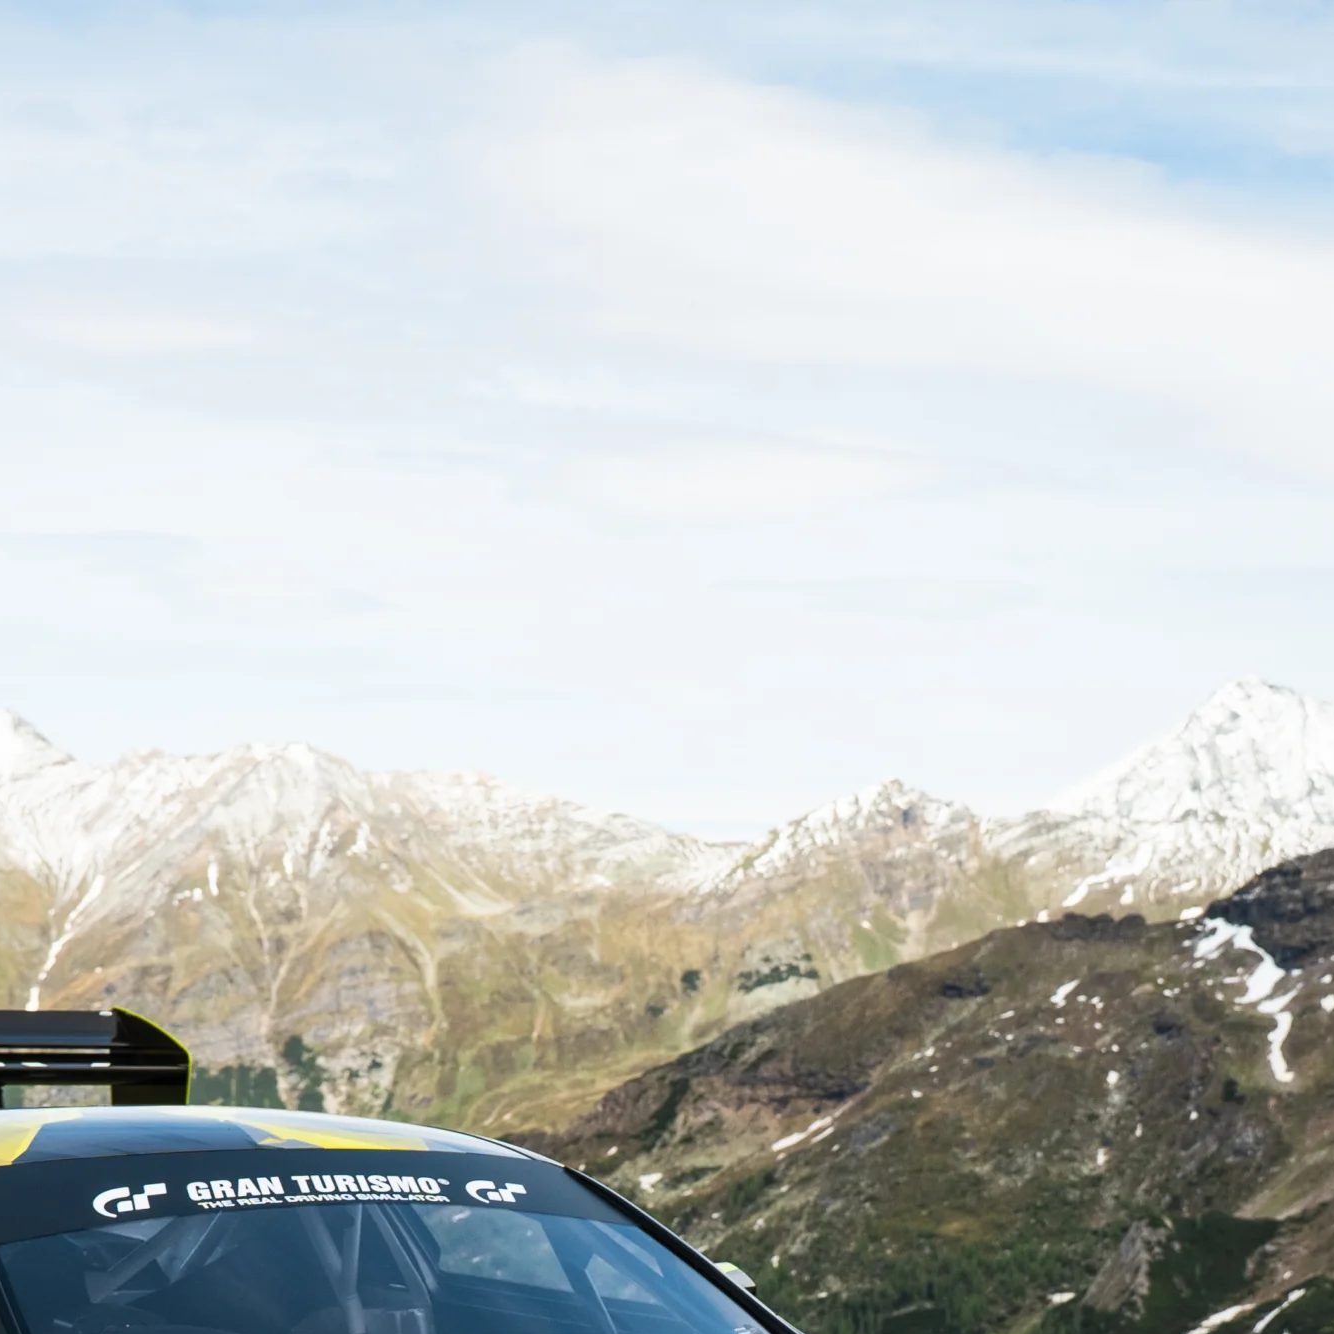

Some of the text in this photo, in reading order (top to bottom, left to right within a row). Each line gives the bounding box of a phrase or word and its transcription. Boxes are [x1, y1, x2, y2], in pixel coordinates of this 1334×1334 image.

[186, 1175, 285, 1202] GRAN
[197, 1193, 451, 1210] THE REAL DRIVING SIMULATOR
